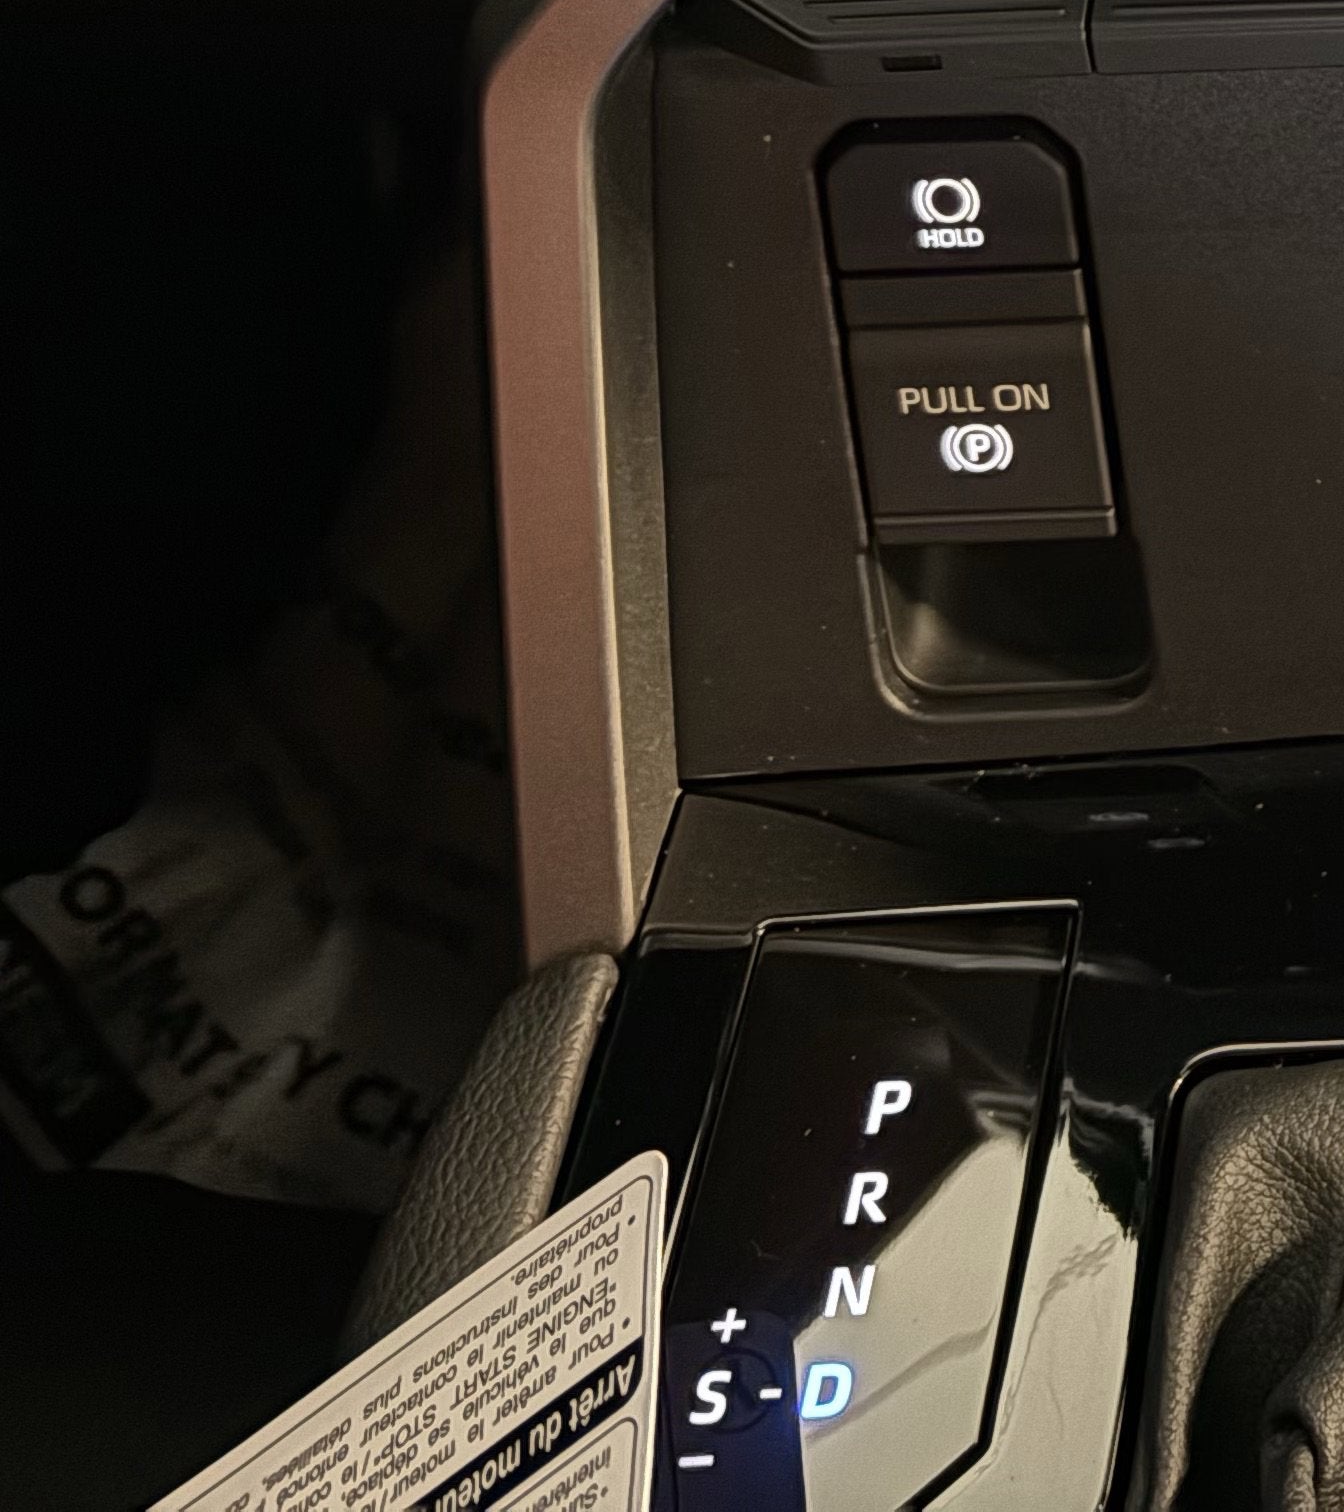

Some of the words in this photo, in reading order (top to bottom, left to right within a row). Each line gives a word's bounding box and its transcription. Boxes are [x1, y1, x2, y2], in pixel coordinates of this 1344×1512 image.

[918, 228, 985, 249] HOLD
[898, 386, 985, 414] PULL
[992, 384, 1050, 411] ON
[864, 1080, 912, 1134] P
[844, 1171, 889, 1224] R
[510, 1193, 624, 1286] propriétaire.
[573, 1222, 621, 1268] Pour
[593, 1248, 619, 1277] ou
[527, 1263, 563, 1301] des
[824, 1265, 876, 1317] N
[492, 1272, 582, 1352] maintenir
[525, 1277, 617, 1355] "ENGINE
[579, 1298, 616, 1334] que
[412, 1295, 519, 1384] instructions
[466, 1343, 484, 1368] le
[549, 1333, 567, 1357] le
[568, 1322, 615, 1370] Pour
[363, 1374, 402, 1420] plus
[450, 1345, 517, 1411] START
[462, 1354, 541, 1421] véhicule
[492, 1364, 557, 1427] arrêter
[569, 1354, 636, 1432] Arrêt
[689, 1370, 732, 1425] S
[801, 1363, 852, 1419] D
[359, 1364, 458, 1448] contacteur
[467, 1418, 484, 1444] le
[261, 1416, 352, 1491] détaillées,
[428, 1419, 451, 1447] se
[529, 1410, 563, 1457] du
[276, 1443, 350, 1512] enfoncé
[340, 1443, 419, 1508] déplace,
[435, 1439, 521, 1512] moteur
